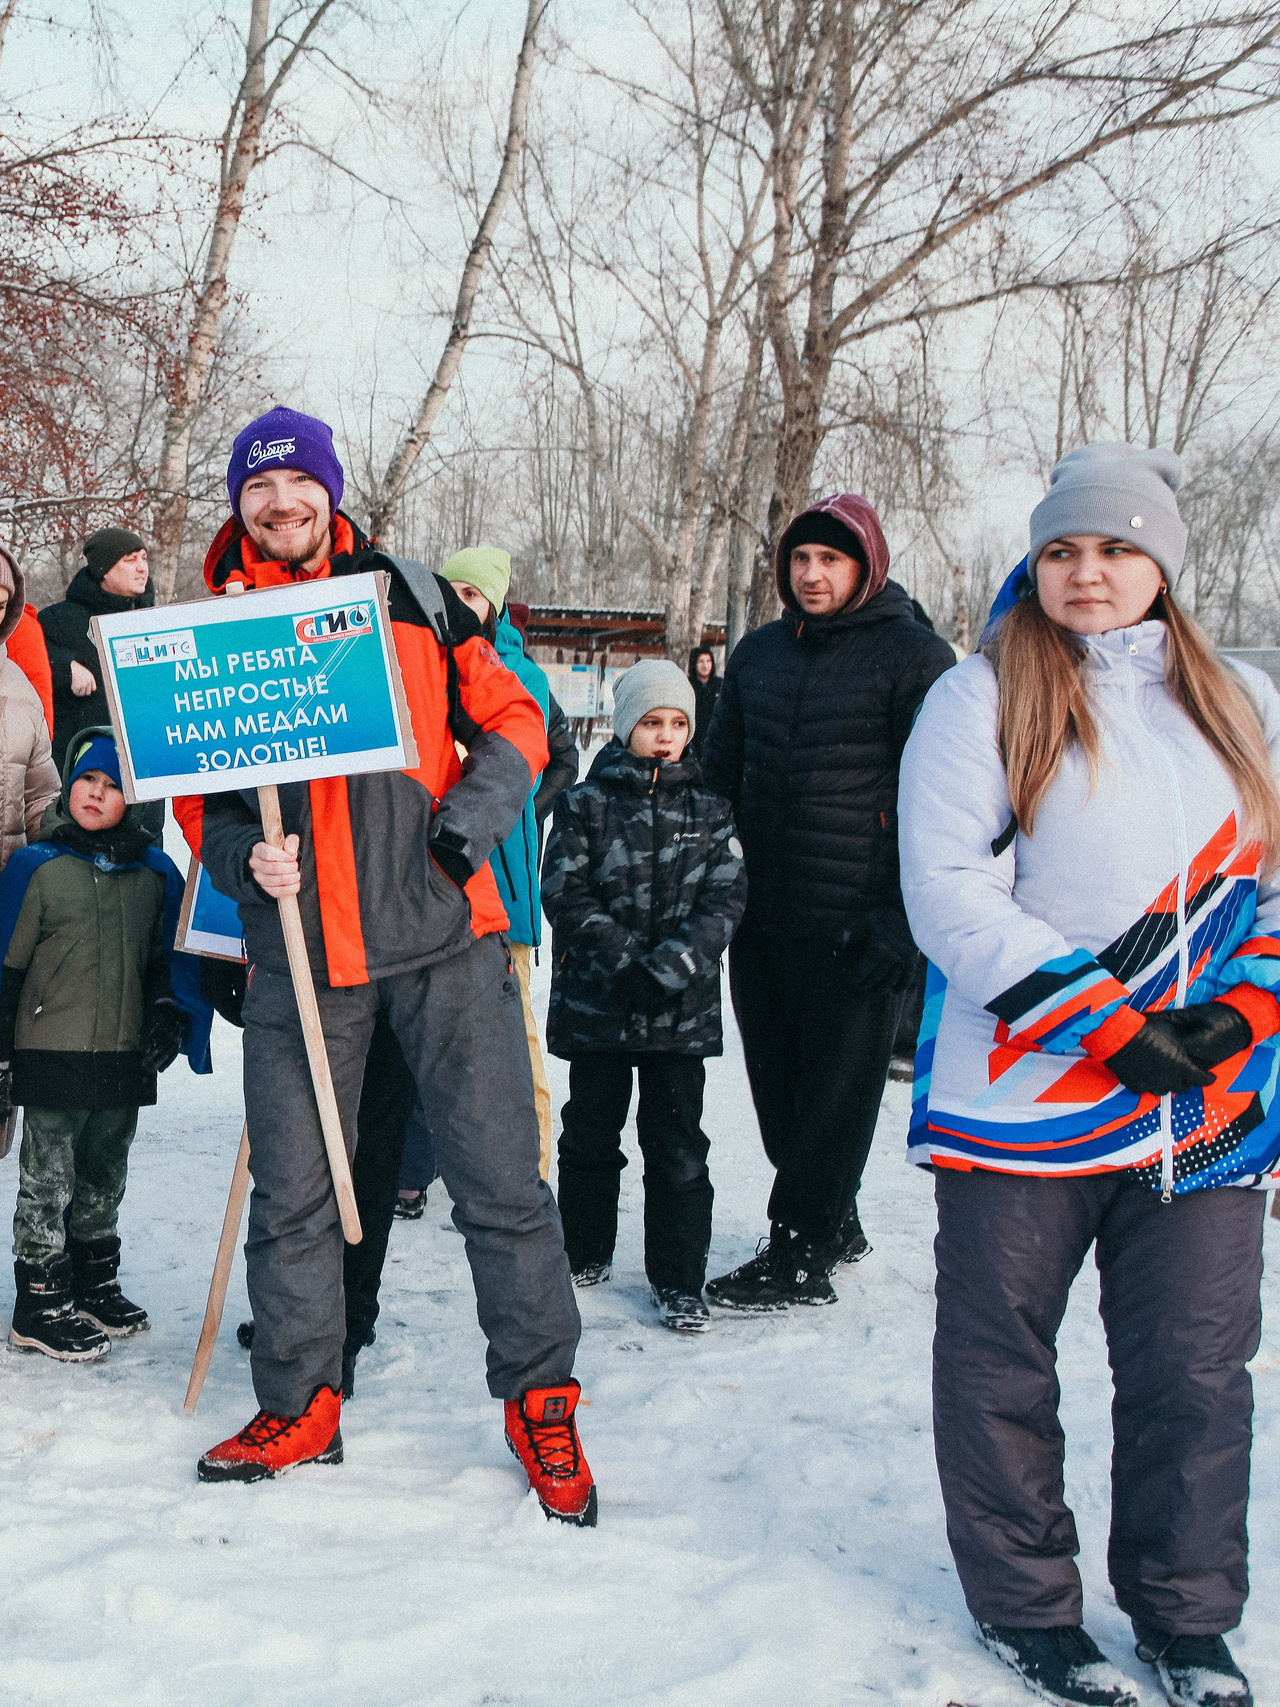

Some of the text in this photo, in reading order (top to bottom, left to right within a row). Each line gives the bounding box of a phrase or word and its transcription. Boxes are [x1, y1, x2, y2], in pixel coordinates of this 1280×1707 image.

[136, 641, 190, 662] ЦИТС
[174, 645, 318, 682] МЫ РЕБЯТА
[173, 674, 329, 713] НЕПРОСТЫЕ
[165, 703, 348, 745] НАМ МЕДАЛИ
[196, 736, 328, 773] ЗОЛОТЫЕ!
